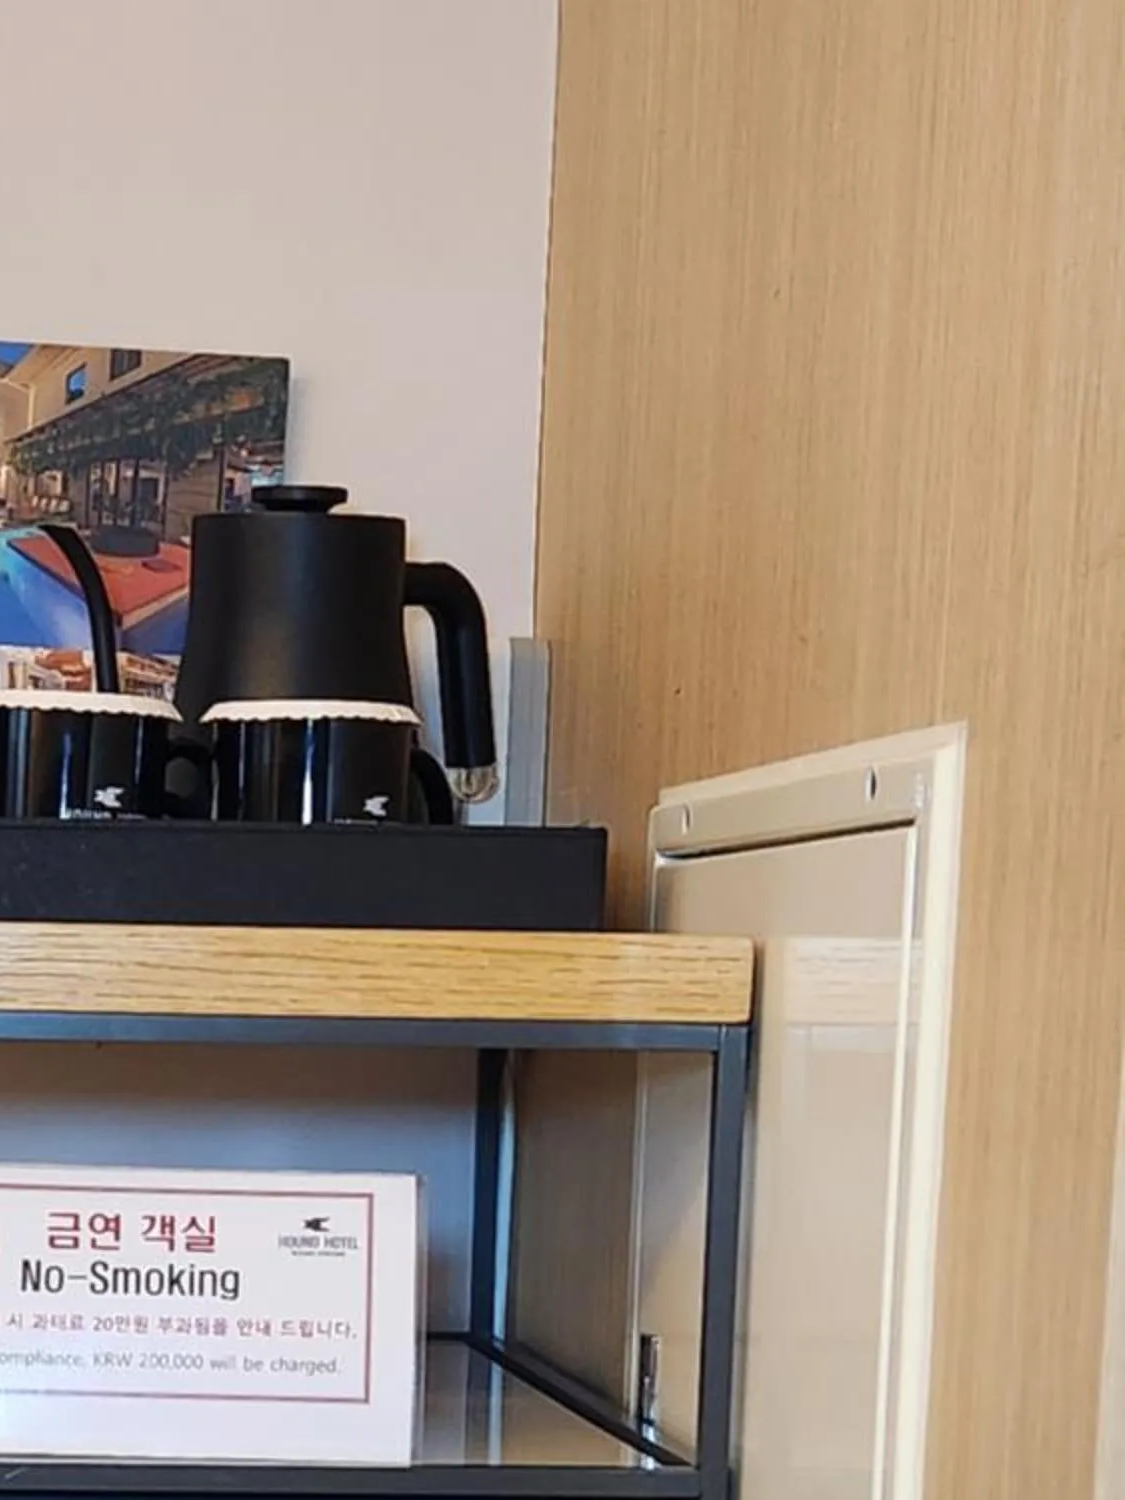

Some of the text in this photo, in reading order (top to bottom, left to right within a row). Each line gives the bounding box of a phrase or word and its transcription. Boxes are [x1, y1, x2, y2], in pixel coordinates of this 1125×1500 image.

[47, 1212, 217, 1253] 금연 객실
[20, 1259, 240, 1301] No-Smoking
[7, 1312, 24, 1330] 시
[92, 1315, 149, 1334] 20만원
[236, 1318, 272, 1337] 안내
[280, 1319, 358, 1340] 드립니다.
[92, 1352, 134, 1368] KRW
[209, 1355, 237, 1371] will
[243, 1357, 265, 1373] be
